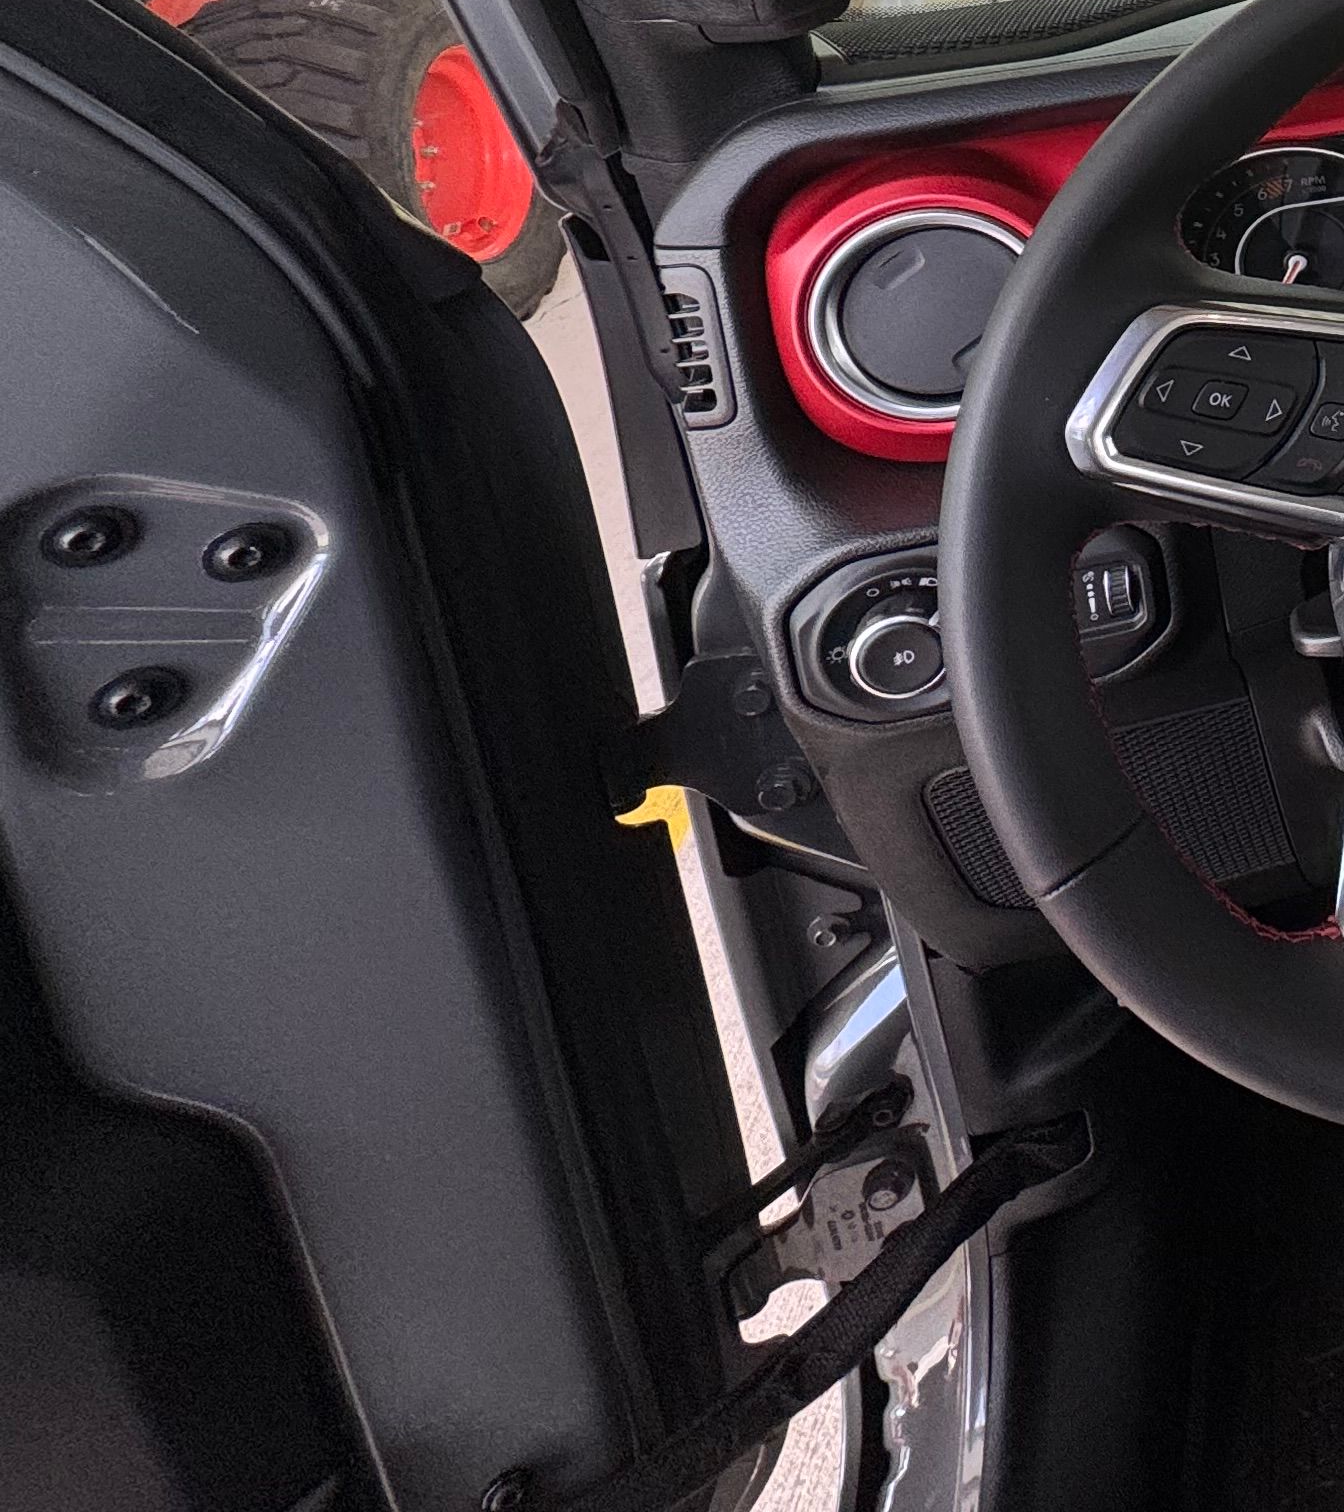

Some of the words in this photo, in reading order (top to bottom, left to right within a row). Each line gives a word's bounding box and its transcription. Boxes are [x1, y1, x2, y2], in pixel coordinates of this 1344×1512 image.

[1284, 179, 1293, 193] 7
[1300, 175, 1326, 187] RPM
[1257, 190, 1267, 201] 6
[1234, 203, 1244, 217] 5
[1216, 228, 1227, 240] 4
[1210, 252, 1220, 266] 3
[1208, 392, 1233, 408] OK
